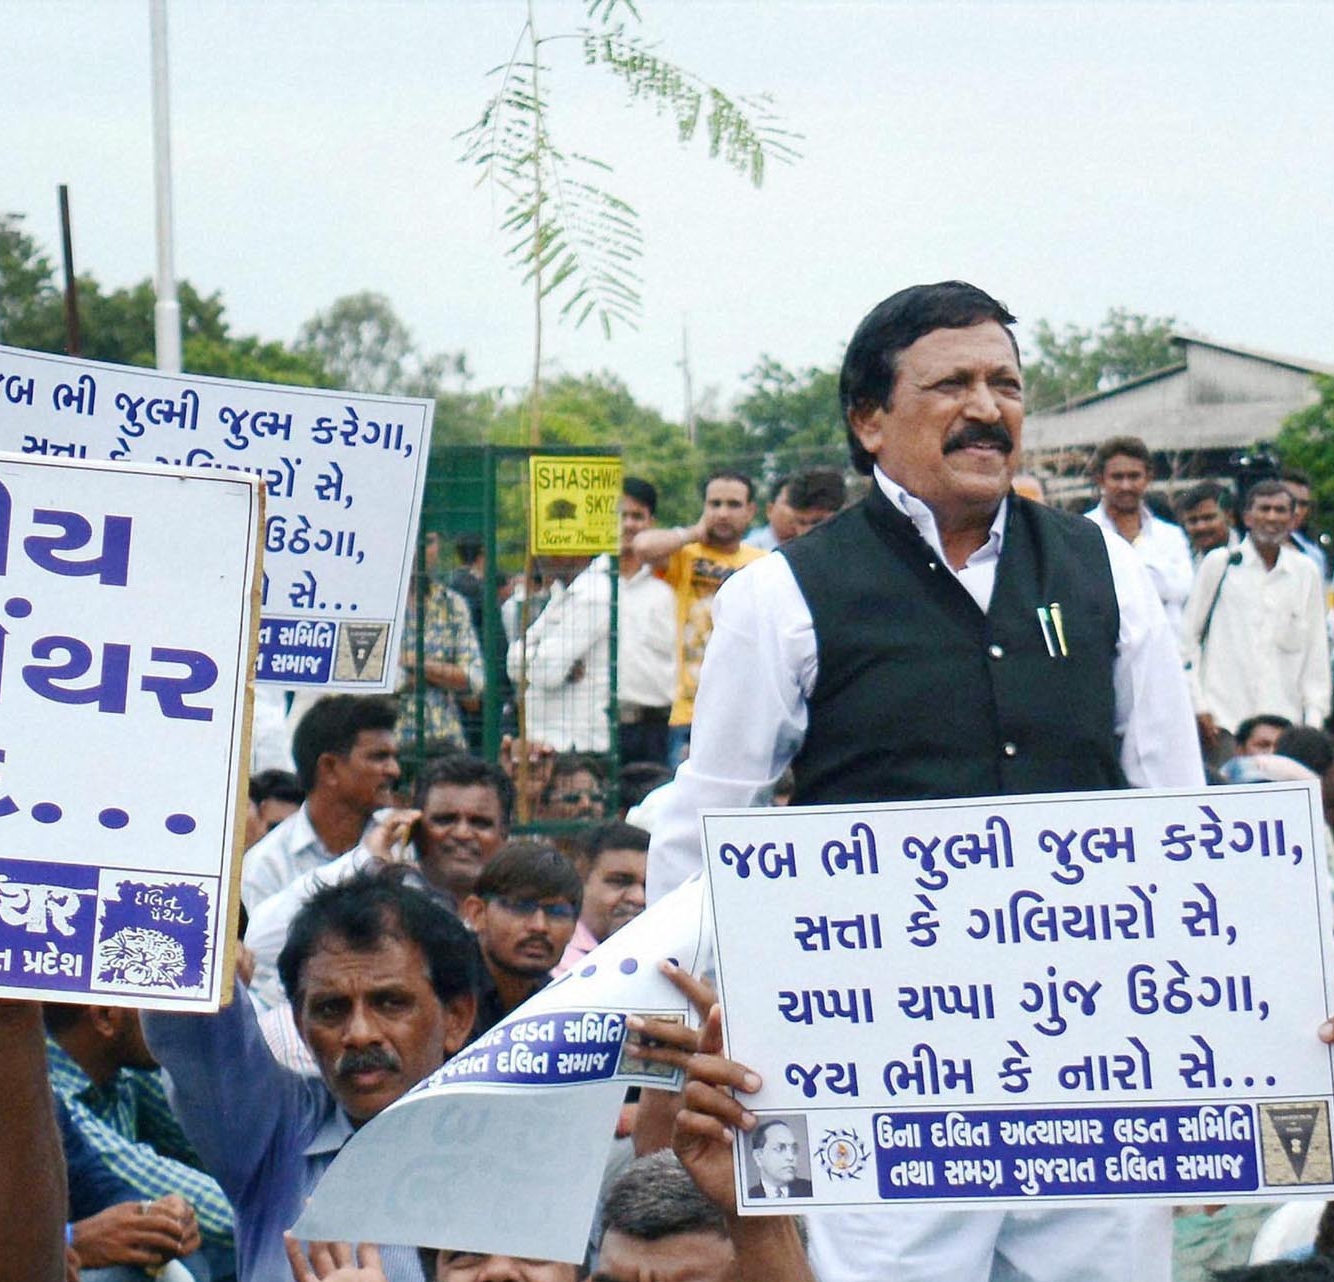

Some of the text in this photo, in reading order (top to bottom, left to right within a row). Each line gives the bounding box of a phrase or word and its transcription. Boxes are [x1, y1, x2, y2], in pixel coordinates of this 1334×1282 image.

[53, 375, 96, 415] ભી
[115, 390, 199, 437] જુલ્મી
[219, 407, 292, 450] જુલ્મ
[312, 407, 412, 457] કરેગા,
[315, 462, 352, 509] સે,
[279, 624, 333, 648] સમિતિ
[271, 654, 322, 674] સમાજ
[720, 806, 1302, 890] જબ ભી જુલ્મી જુલ્મ કરેગા,
[795, 883, 1236, 951] સત્તા કે ગલિયારોં સે,
[22, 944, 82, 977] પ્રદેશ
[779, 960, 1268, 1036] ચપ્પા ચપ્પા ગુંજ ઉઠેગા,
[564, 1013, 623, 1043] સમિતિ
[497, 1044, 609, 1074] દલિત સમાજ
[785, 1037, 1152, 1098] જય ભીમ કે નારો
[877, 1106, 1250, 1148] ઉના દલિત અત્યાચાર લડત સમિતિ
[891, 1146, 1243, 1195] તથા સમગ્ર ગુજરાત દલિત સમાજ
